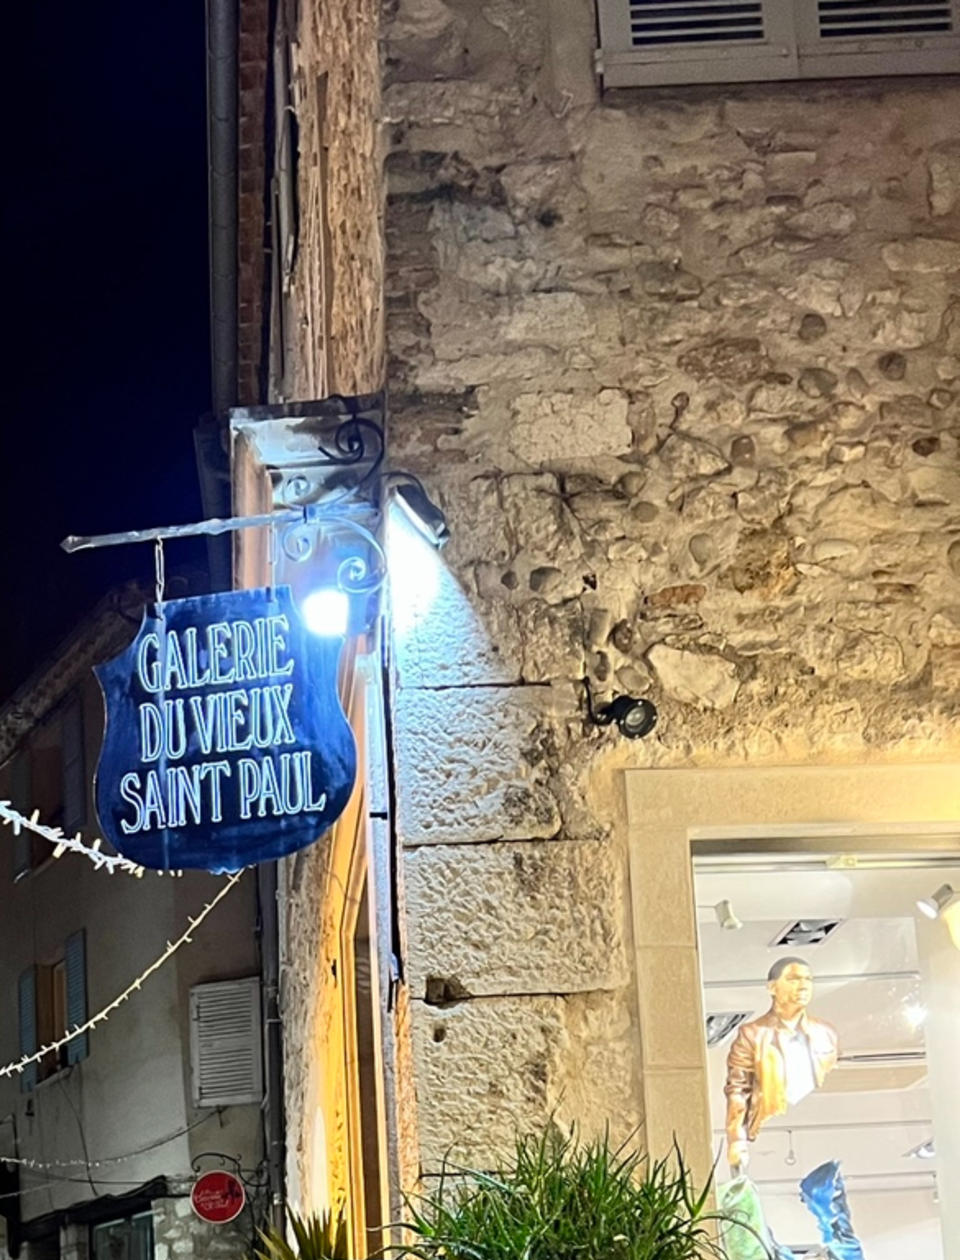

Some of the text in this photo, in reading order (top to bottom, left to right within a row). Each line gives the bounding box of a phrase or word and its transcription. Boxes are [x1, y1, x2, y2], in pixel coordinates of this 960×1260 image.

[139, 614, 295, 693] GALERIE
[140, 683, 296, 763] DU VIEUX
[120, 751, 326, 834] SAINT PAUL
